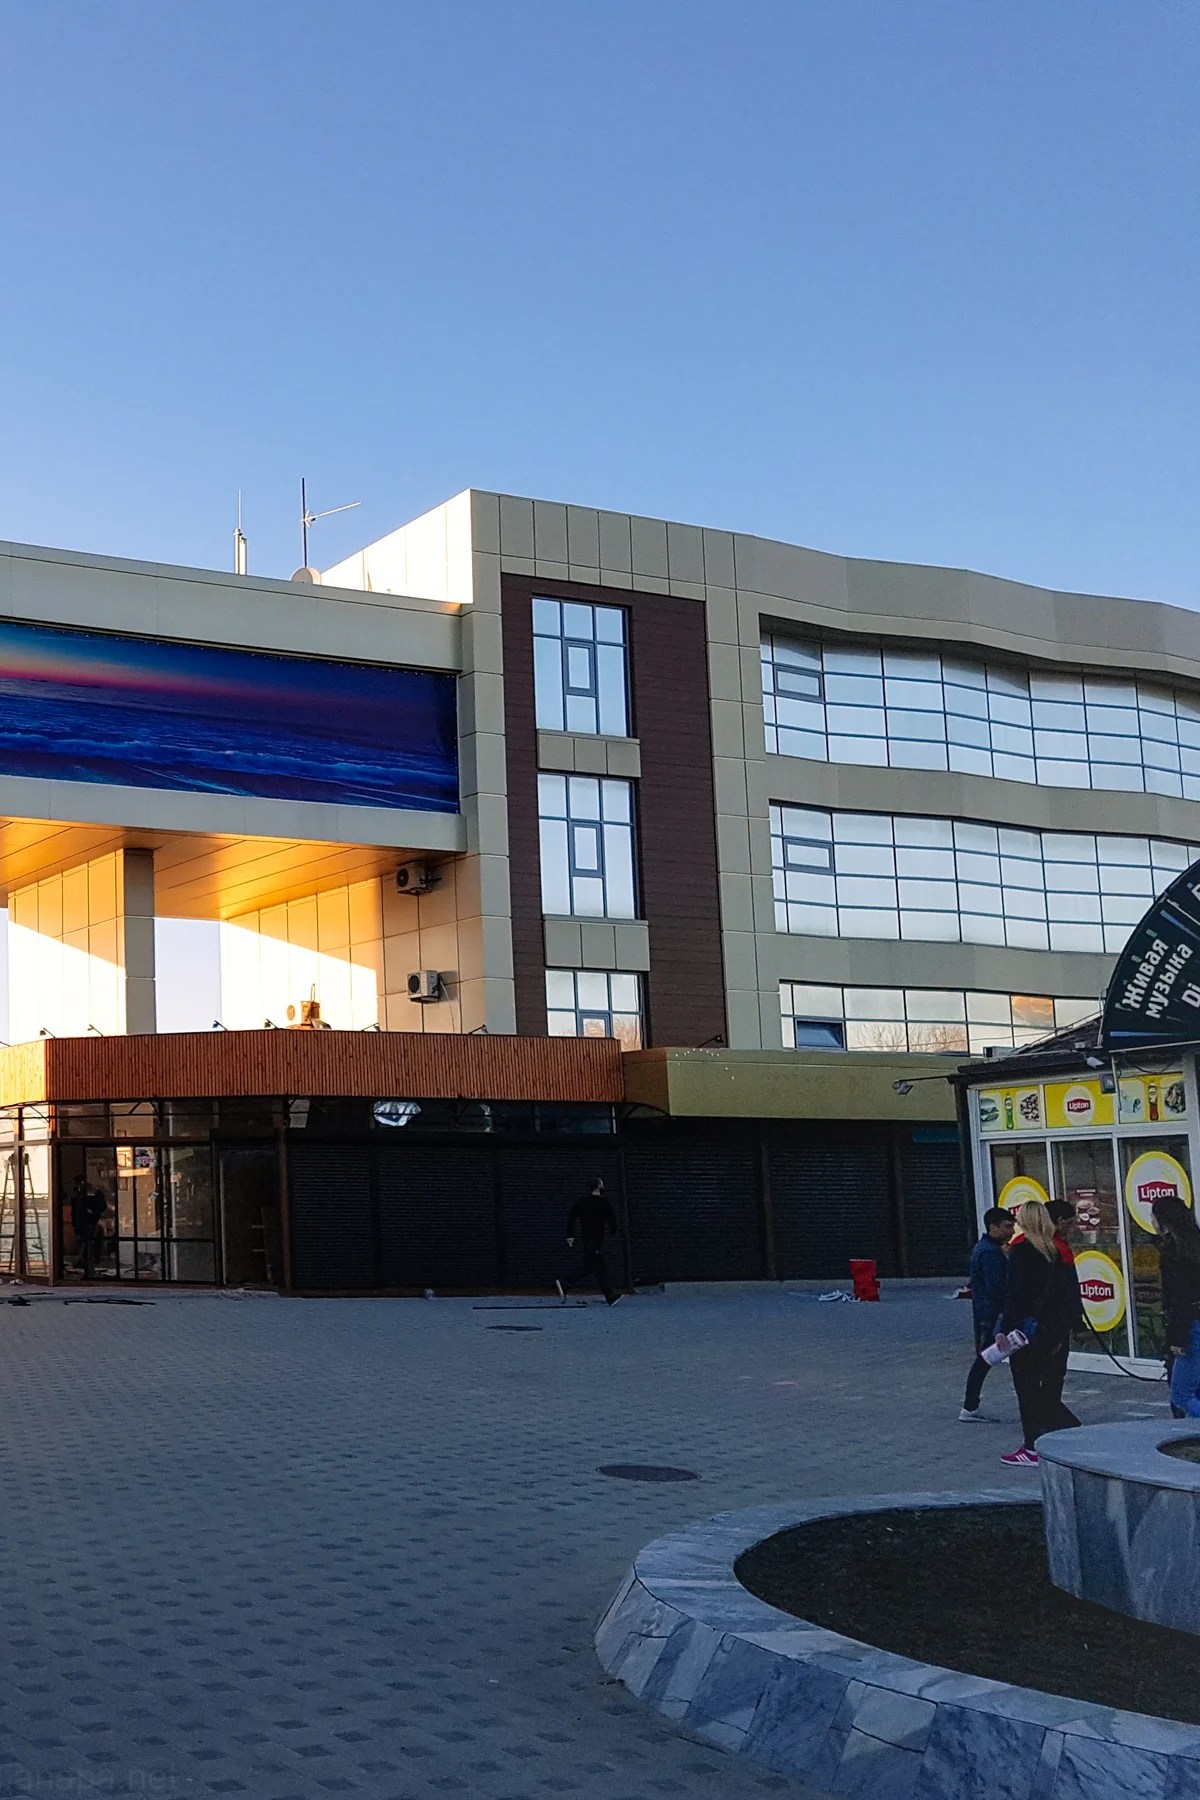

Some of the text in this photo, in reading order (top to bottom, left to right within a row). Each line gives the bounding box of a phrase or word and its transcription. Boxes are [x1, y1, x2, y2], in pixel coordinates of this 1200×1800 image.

[1122, 939, 1169, 1009] Живая
[1146, 943, 1193, 1019] музыка
[1068, 1101, 1090, 1111] Lipton
[1140, 1186, 1175, 1201] Lipton
[1080, 1283, 1112, 1299] Lipton
